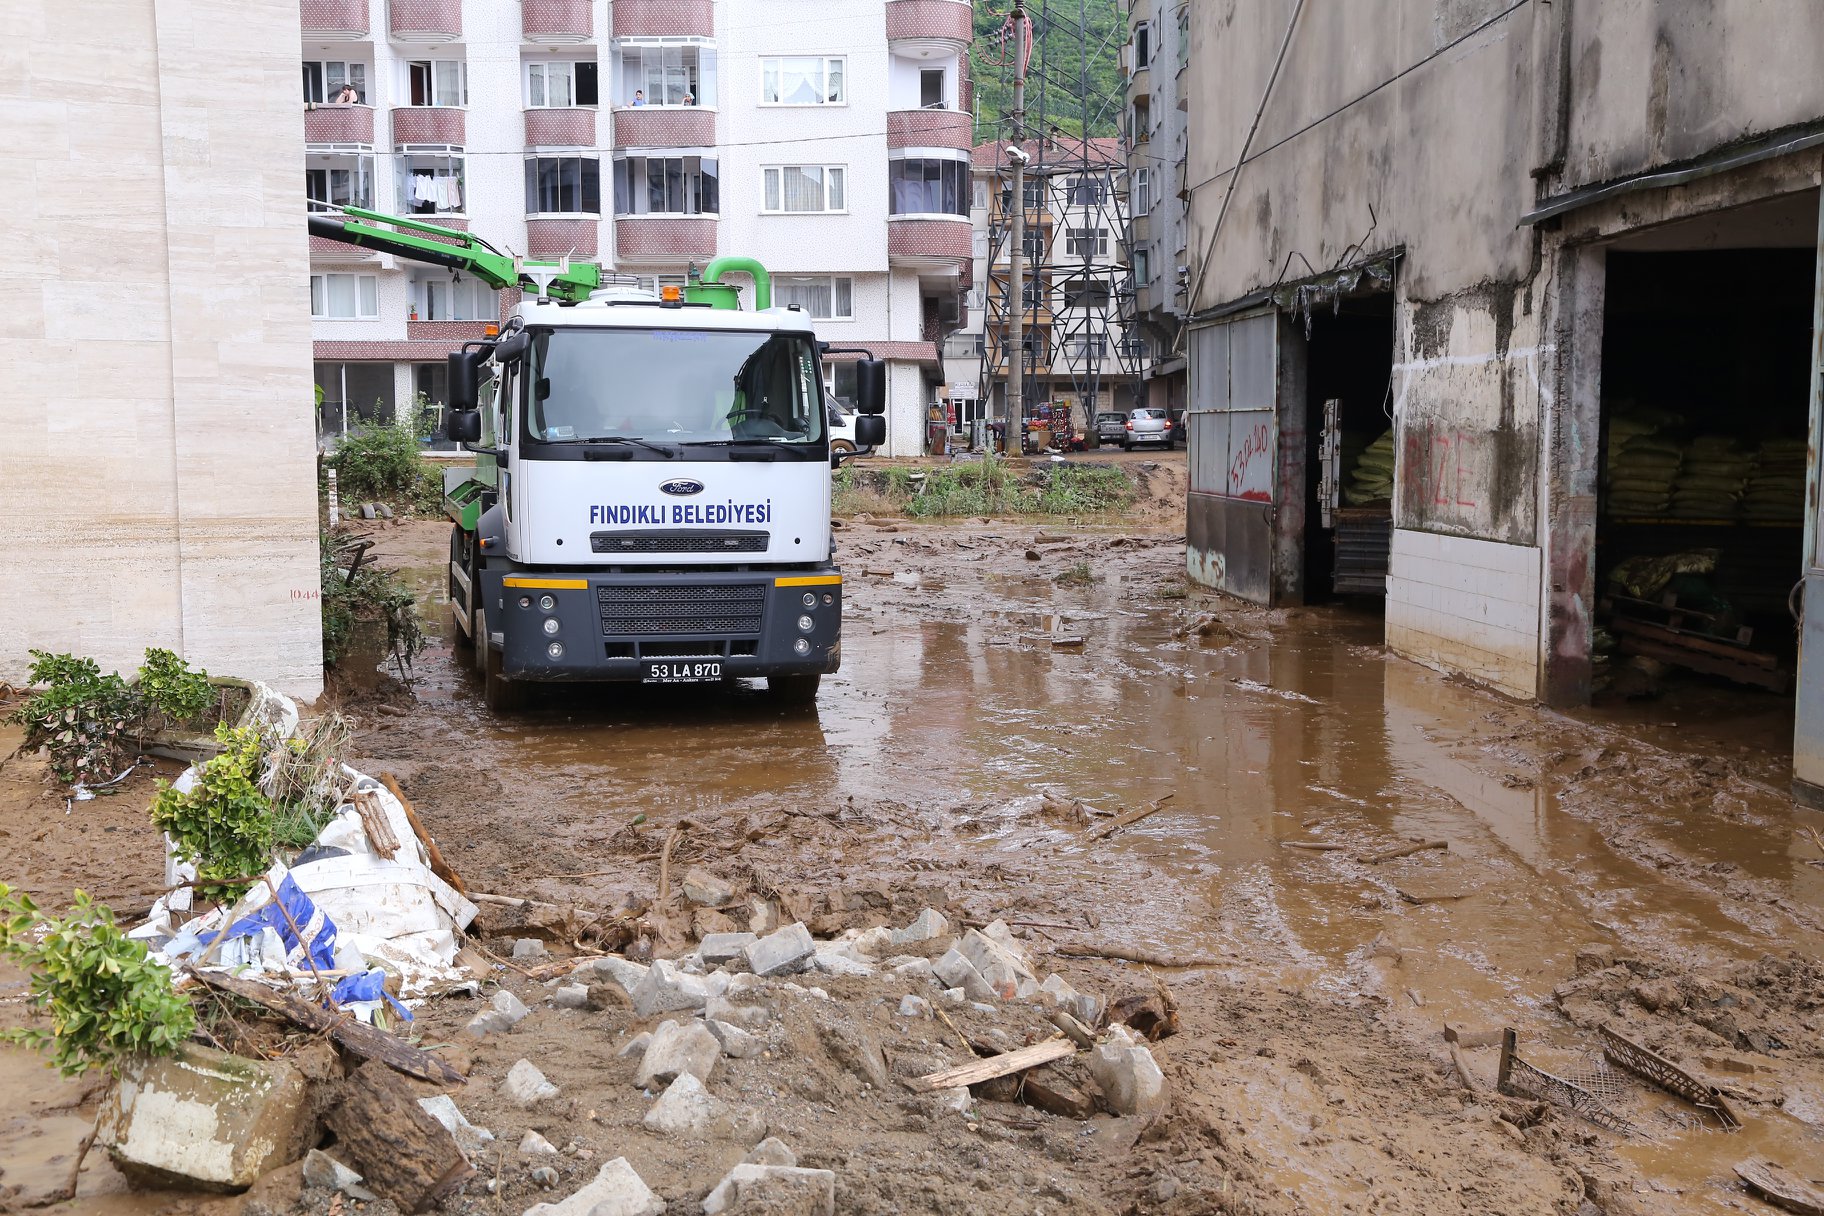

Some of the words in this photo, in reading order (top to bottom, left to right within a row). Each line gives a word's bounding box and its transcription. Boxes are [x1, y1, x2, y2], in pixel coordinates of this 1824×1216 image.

[669, 481, 695, 493] Ford
[589, 505, 665, 524] FINDIKLI
[672, 499, 770, 523] BELEDİYESİ
[290, 588, 319, 602] 1044
[651, 665, 668, 677] 53
[673, 664, 690, 677] LA
[694, 663, 720, 676] 870
